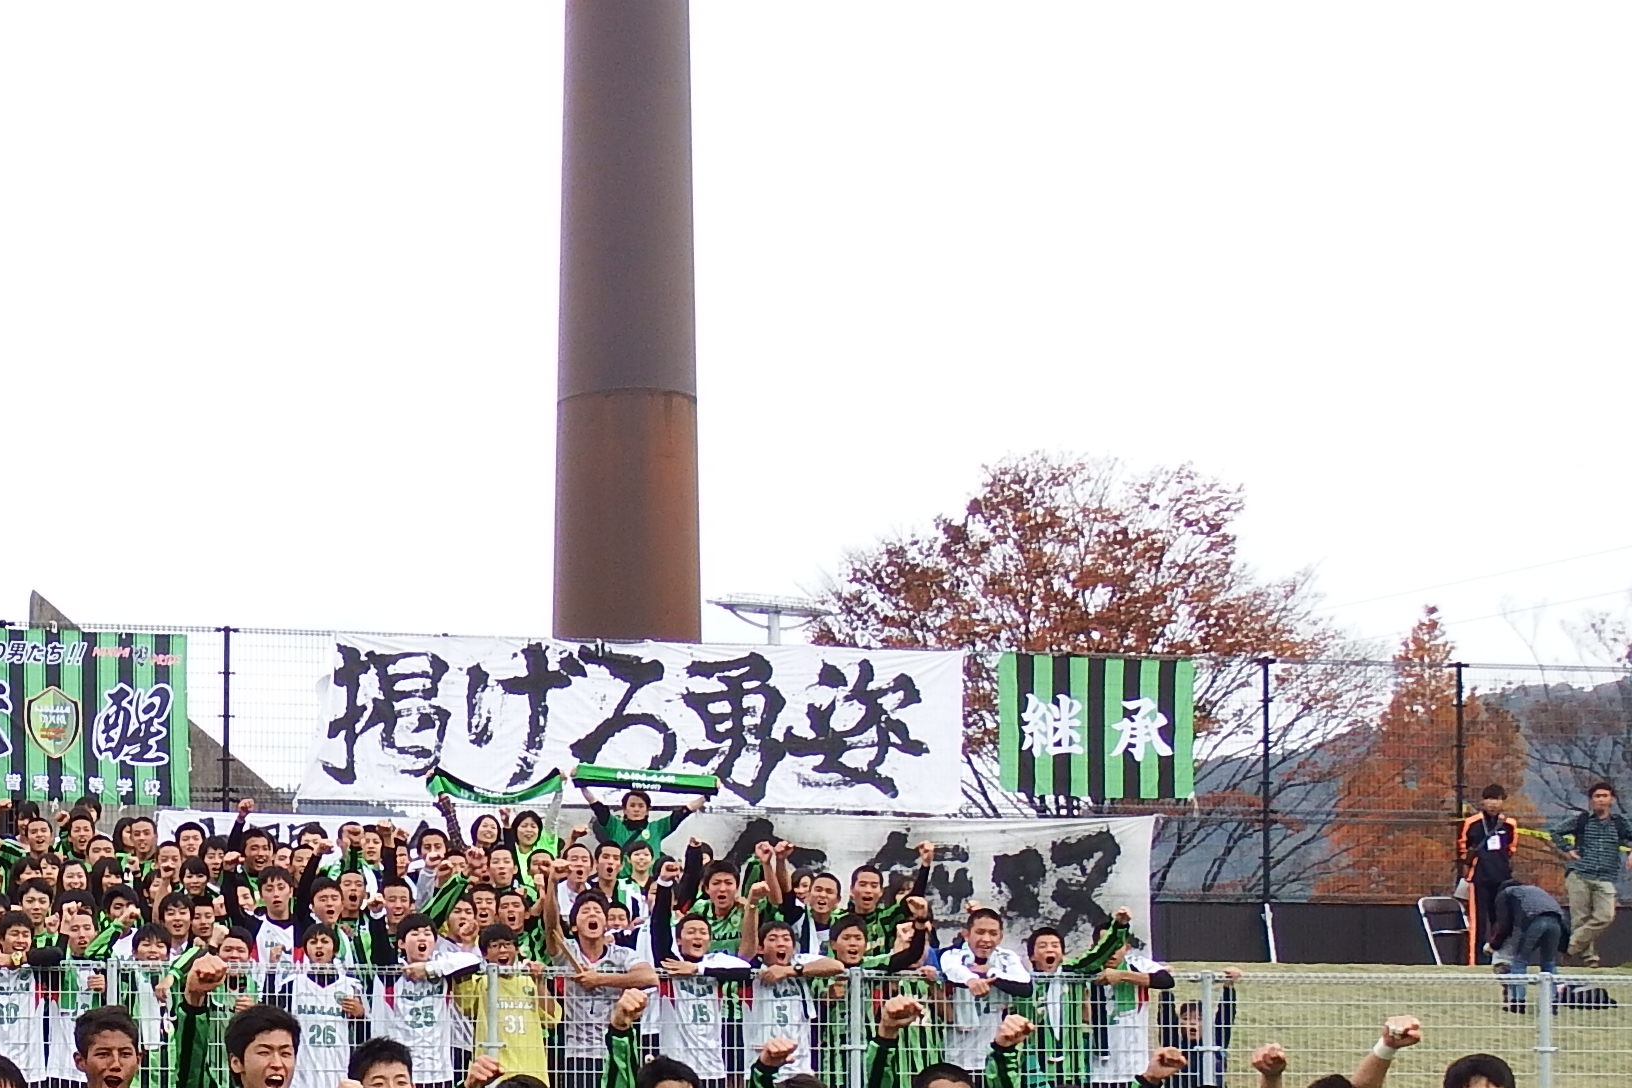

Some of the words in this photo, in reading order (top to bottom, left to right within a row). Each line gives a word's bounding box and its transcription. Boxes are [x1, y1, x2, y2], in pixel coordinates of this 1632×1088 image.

[1020, 693, 1174, 762] 継承
[308, 1024, 337, 1048] 26
[504, 1016, 527, 1034] 31
